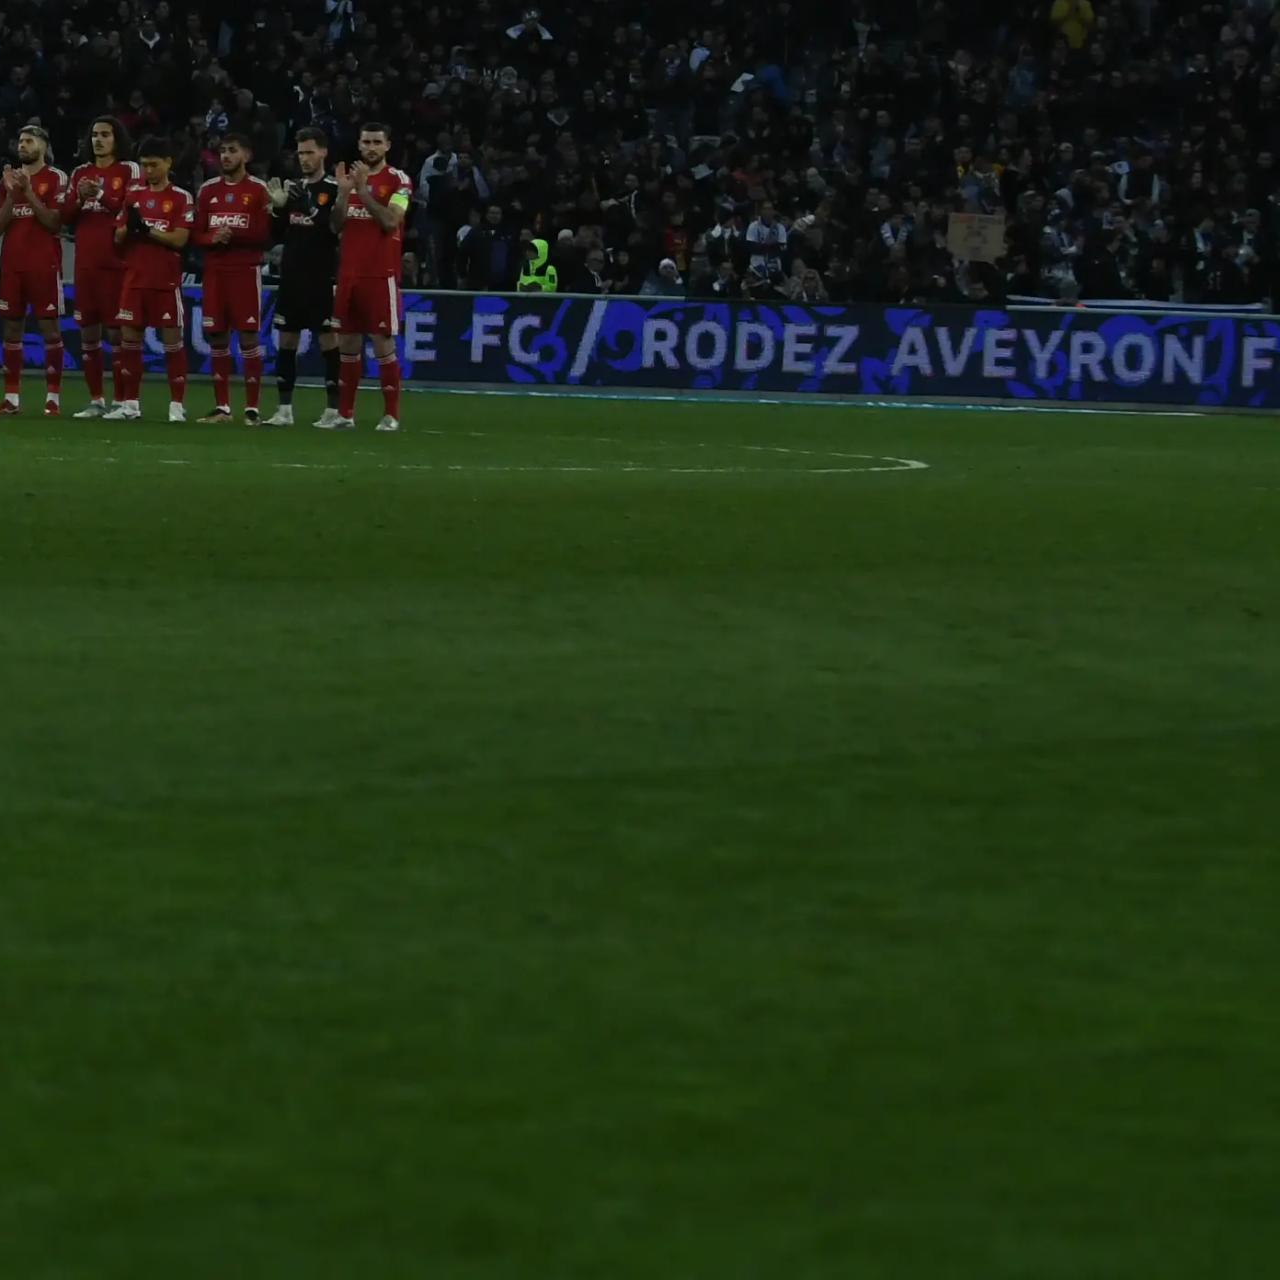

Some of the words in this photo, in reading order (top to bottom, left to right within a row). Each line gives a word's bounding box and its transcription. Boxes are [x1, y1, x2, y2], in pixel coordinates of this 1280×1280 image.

[210, 215, 247, 227] Betclic
[470, 314, 541, 364] FC
[641, 318, 860, 375] RODEZ
[890, 325, 1206, 386] AVEYRON
